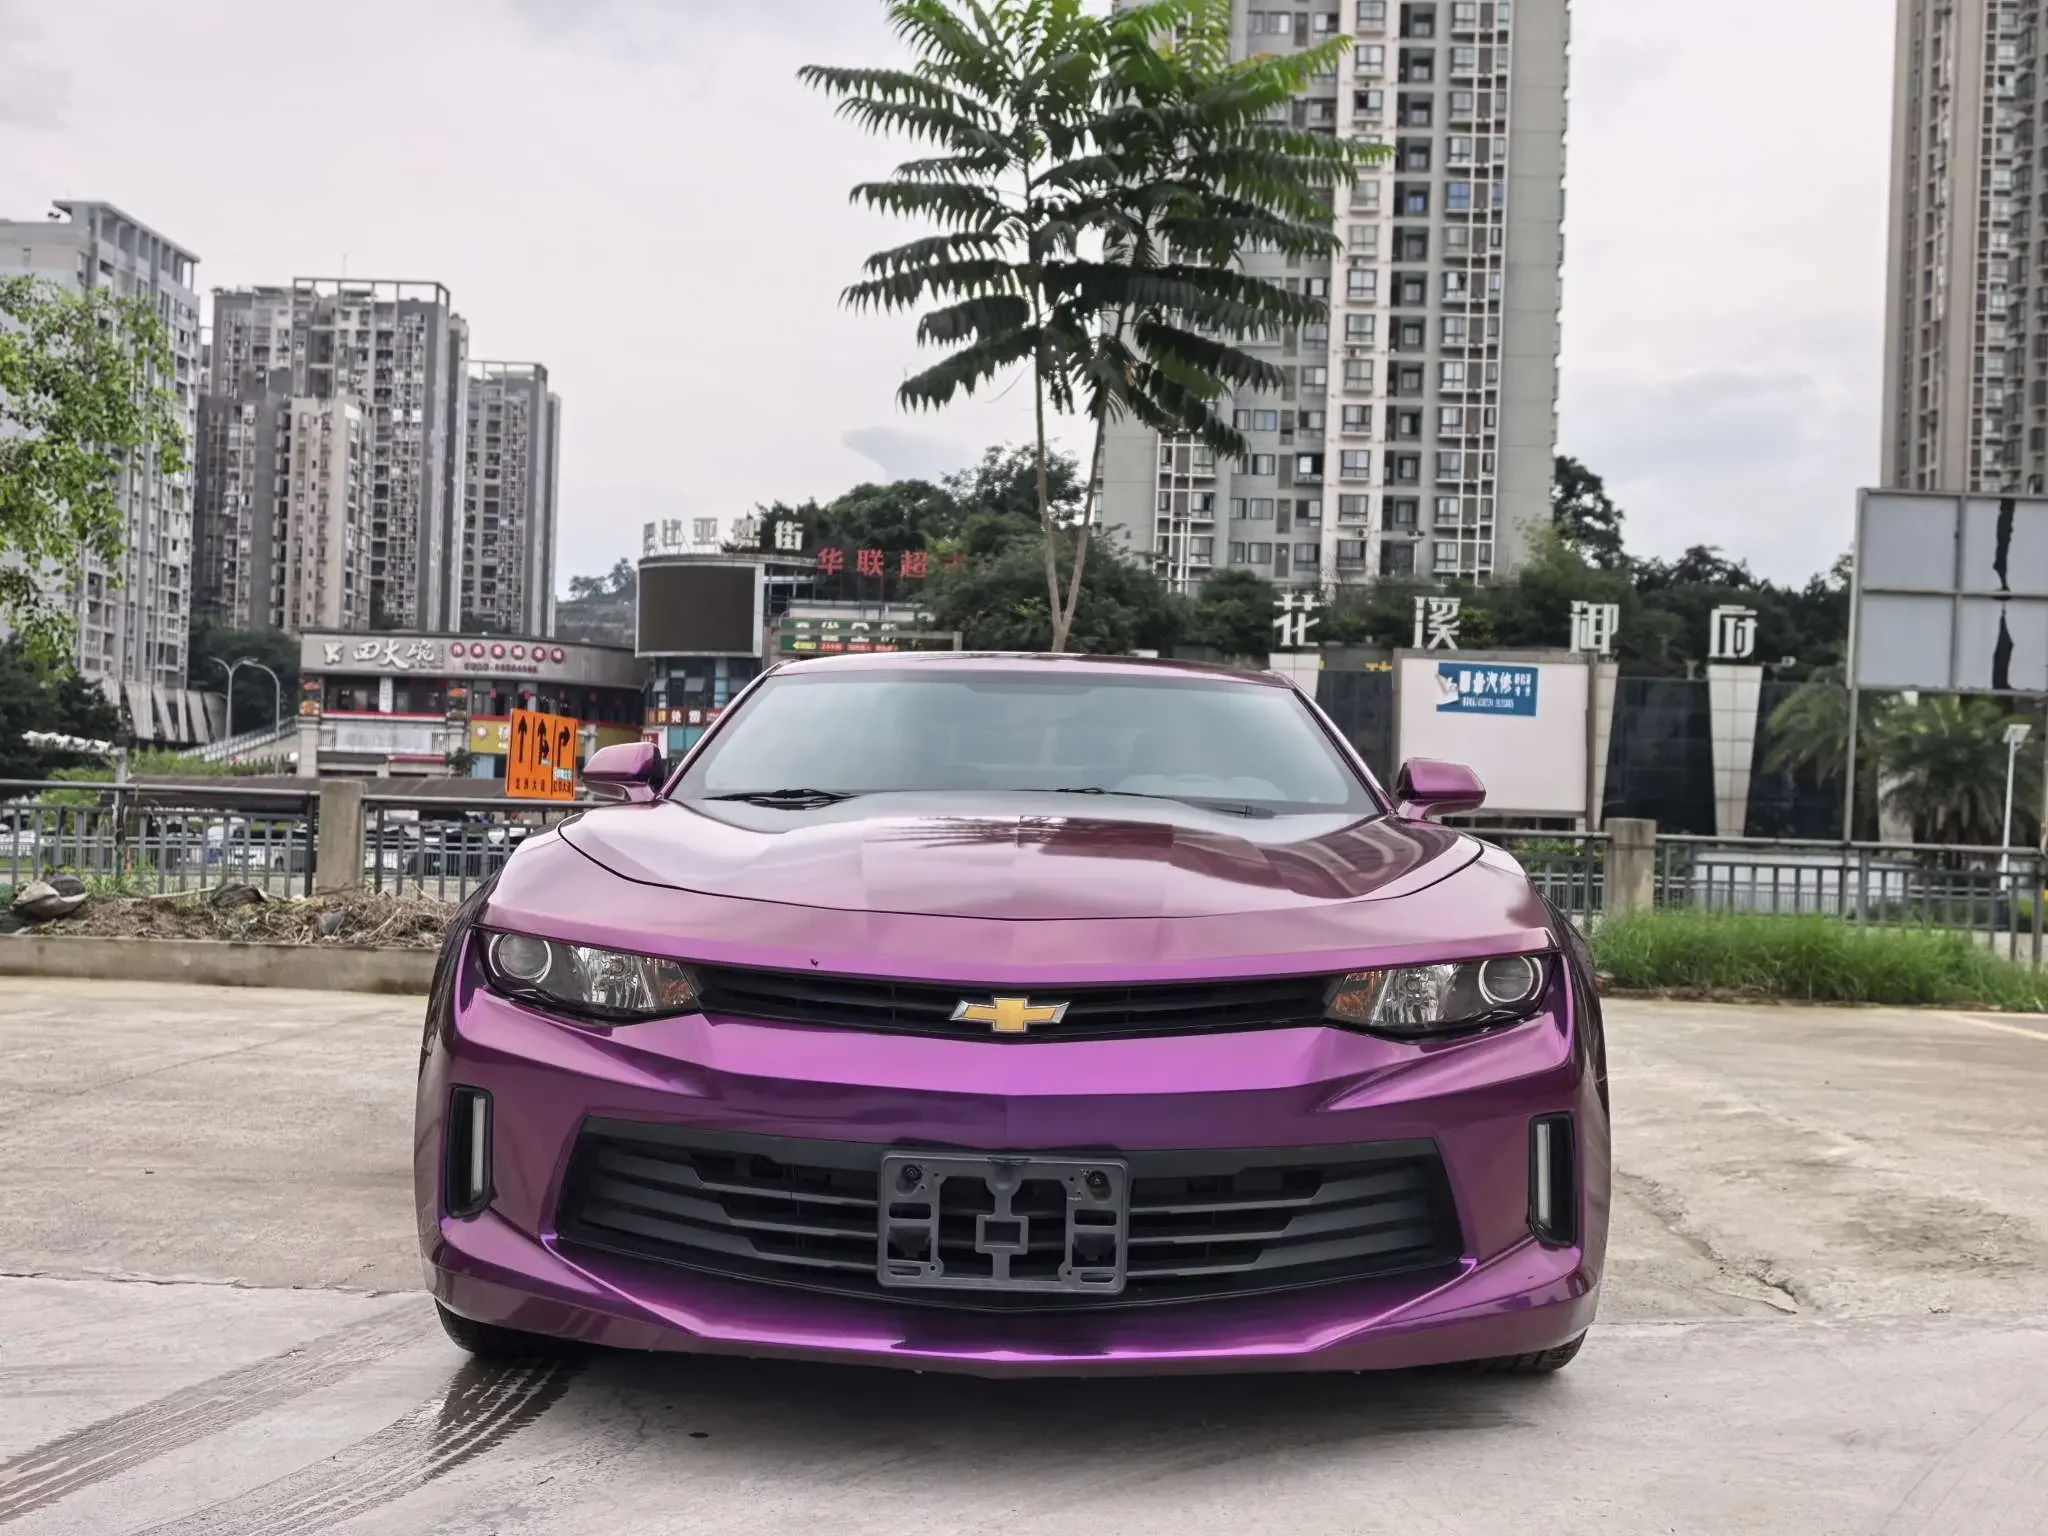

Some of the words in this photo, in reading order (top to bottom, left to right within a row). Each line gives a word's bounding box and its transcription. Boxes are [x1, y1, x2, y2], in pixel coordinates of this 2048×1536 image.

[817, 547, 964, 577] 华联超
[1273, 593, 1758, 660] 花溪御府
